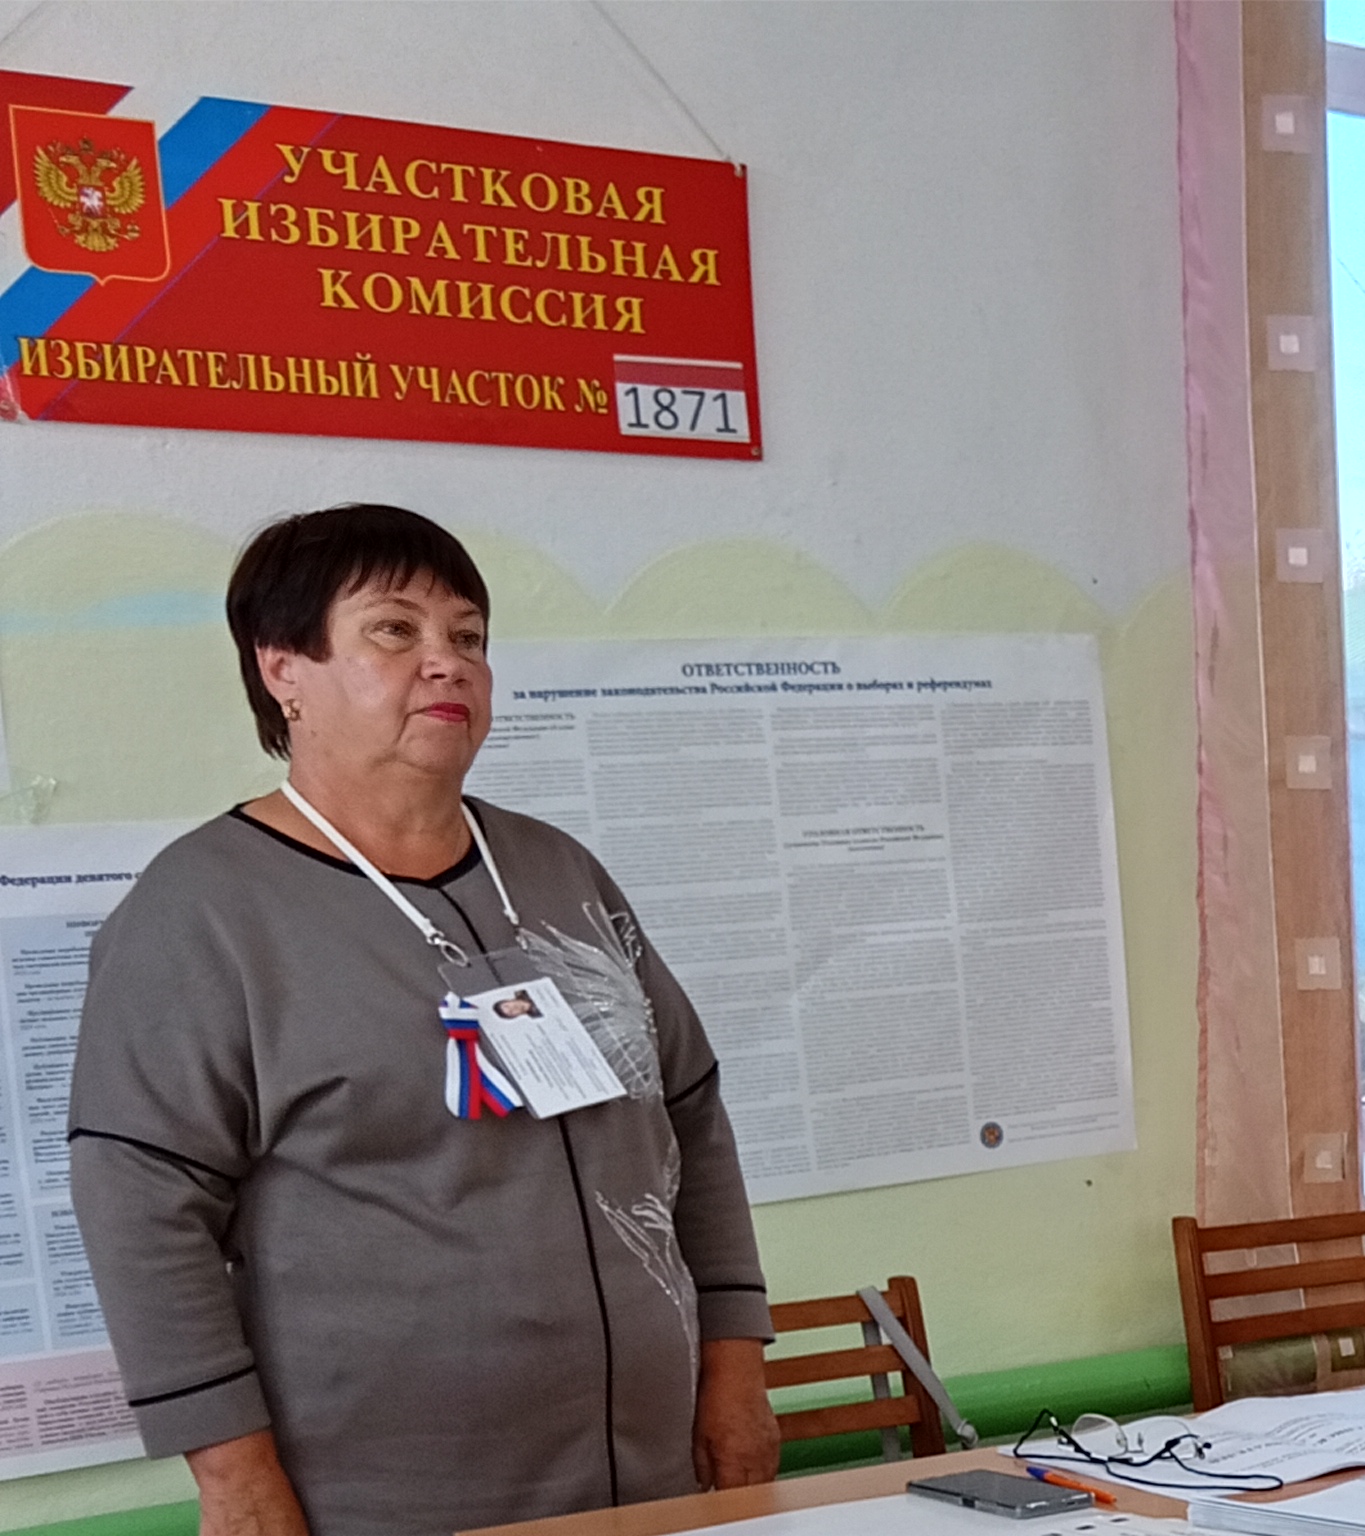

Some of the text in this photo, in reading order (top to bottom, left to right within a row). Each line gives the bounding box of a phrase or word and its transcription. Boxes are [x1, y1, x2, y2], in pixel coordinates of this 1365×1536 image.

[275, 143, 667, 225] УЧАСТКОВАЯ
[219, 198, 722, 286] ИЗБИРАТЕЛЬНАЯ
[318, 268, 646, 335] КОМИССИЯ
[17, 336, 739, 435] ИЗБИРАТЕЛЬНЫЙ УЧАСТОК № 1871
[529, 688, 597, 702] нарушение
[601, 684, 707, 698] законодательства
[710, 681, 778, 695] Российской
[781, 681, 843, 696] Федерации
[856, 680, 904, 693] выборах
[917, 678, 993, 693] референдумах
[682, 661, 842, 677] ОТВЕТСТВЕННОСТЬ
[0, 875, 72, 888] Федерации
[75, 872, 132, 884] девятого
